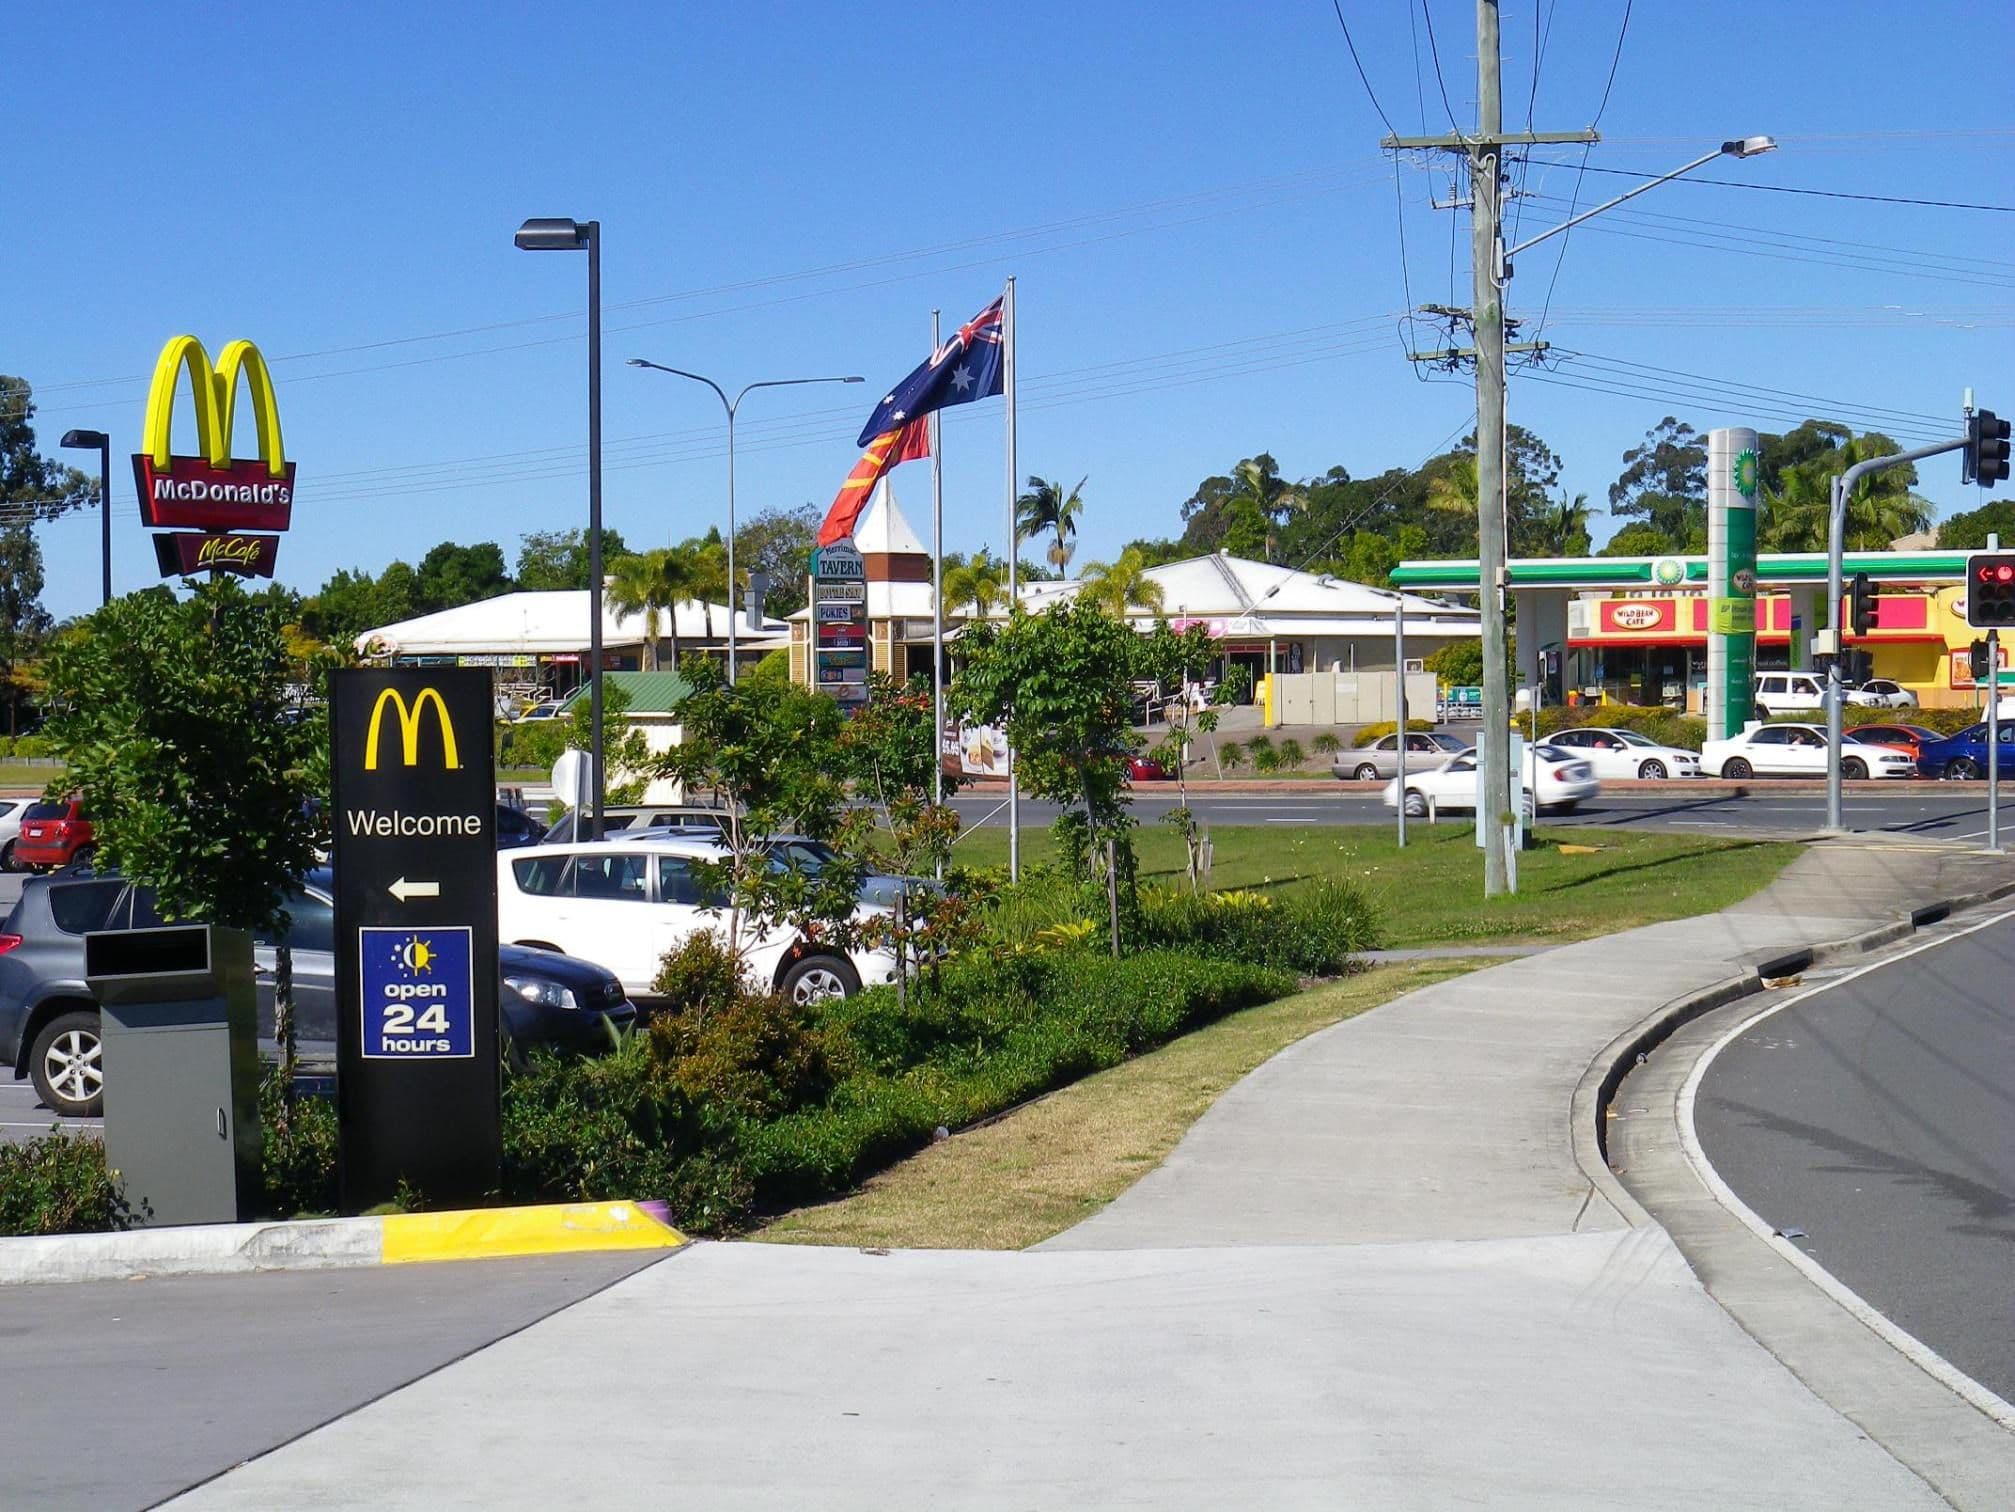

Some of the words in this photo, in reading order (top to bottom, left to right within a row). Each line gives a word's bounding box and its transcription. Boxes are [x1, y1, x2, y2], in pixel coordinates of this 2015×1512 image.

[154, 479, 290, 505] McDonald's
[820, 560, 863, 575] TAVERN
[820, 607, 848, 619] POKIES
[347, 810, 482, 836] Welcome
[384, 983, 447, 1000] open
[382, 1004, 450, 1034] 24
[382, 1036, 451, 1053] hours
